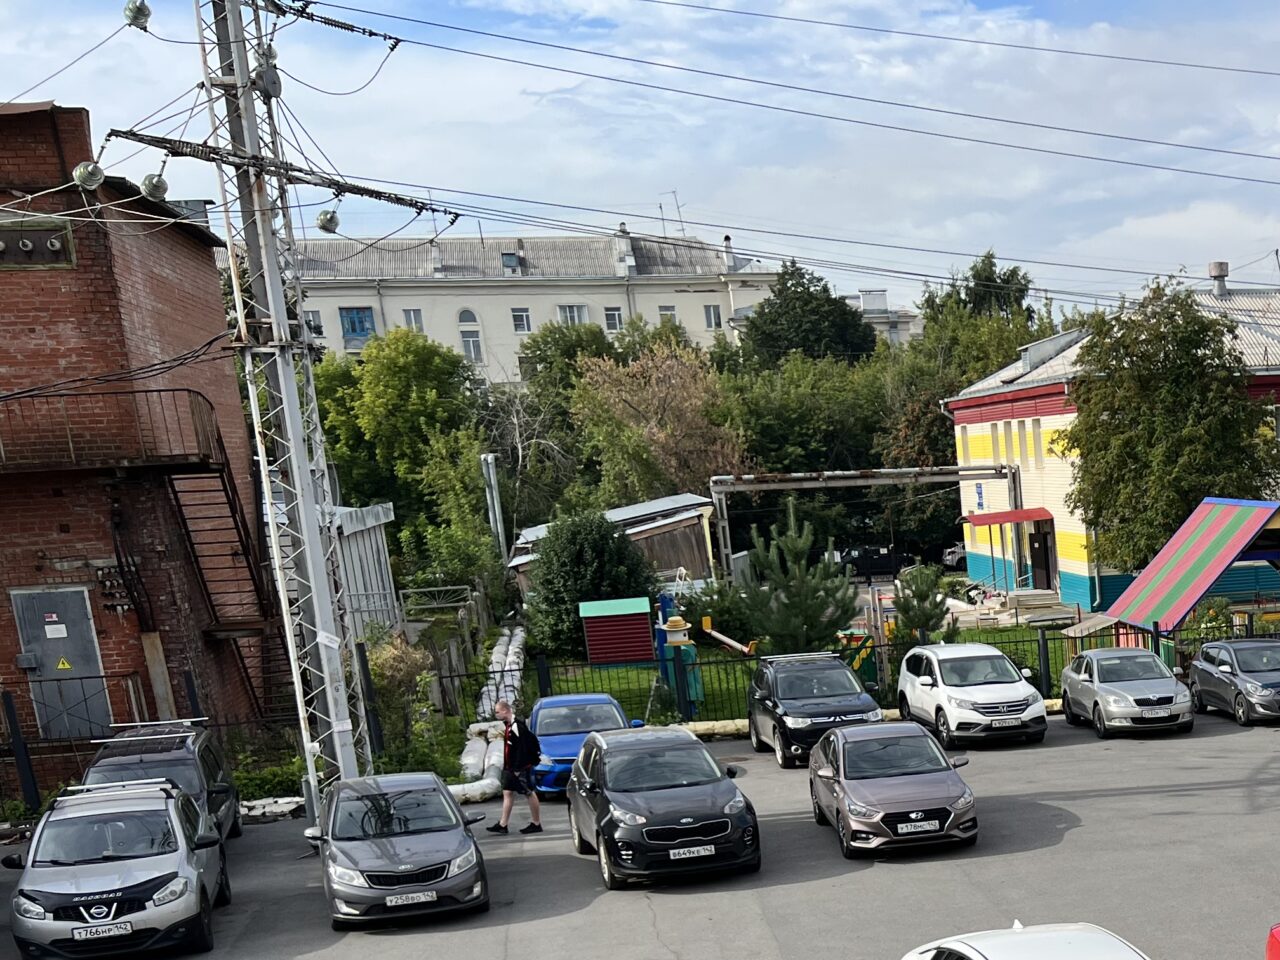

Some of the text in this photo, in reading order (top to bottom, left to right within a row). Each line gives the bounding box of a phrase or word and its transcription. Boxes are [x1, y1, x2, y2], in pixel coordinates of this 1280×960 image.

[422, 890, 434, 899] 142
[77, 923, 128, 938] Т766НР 142
